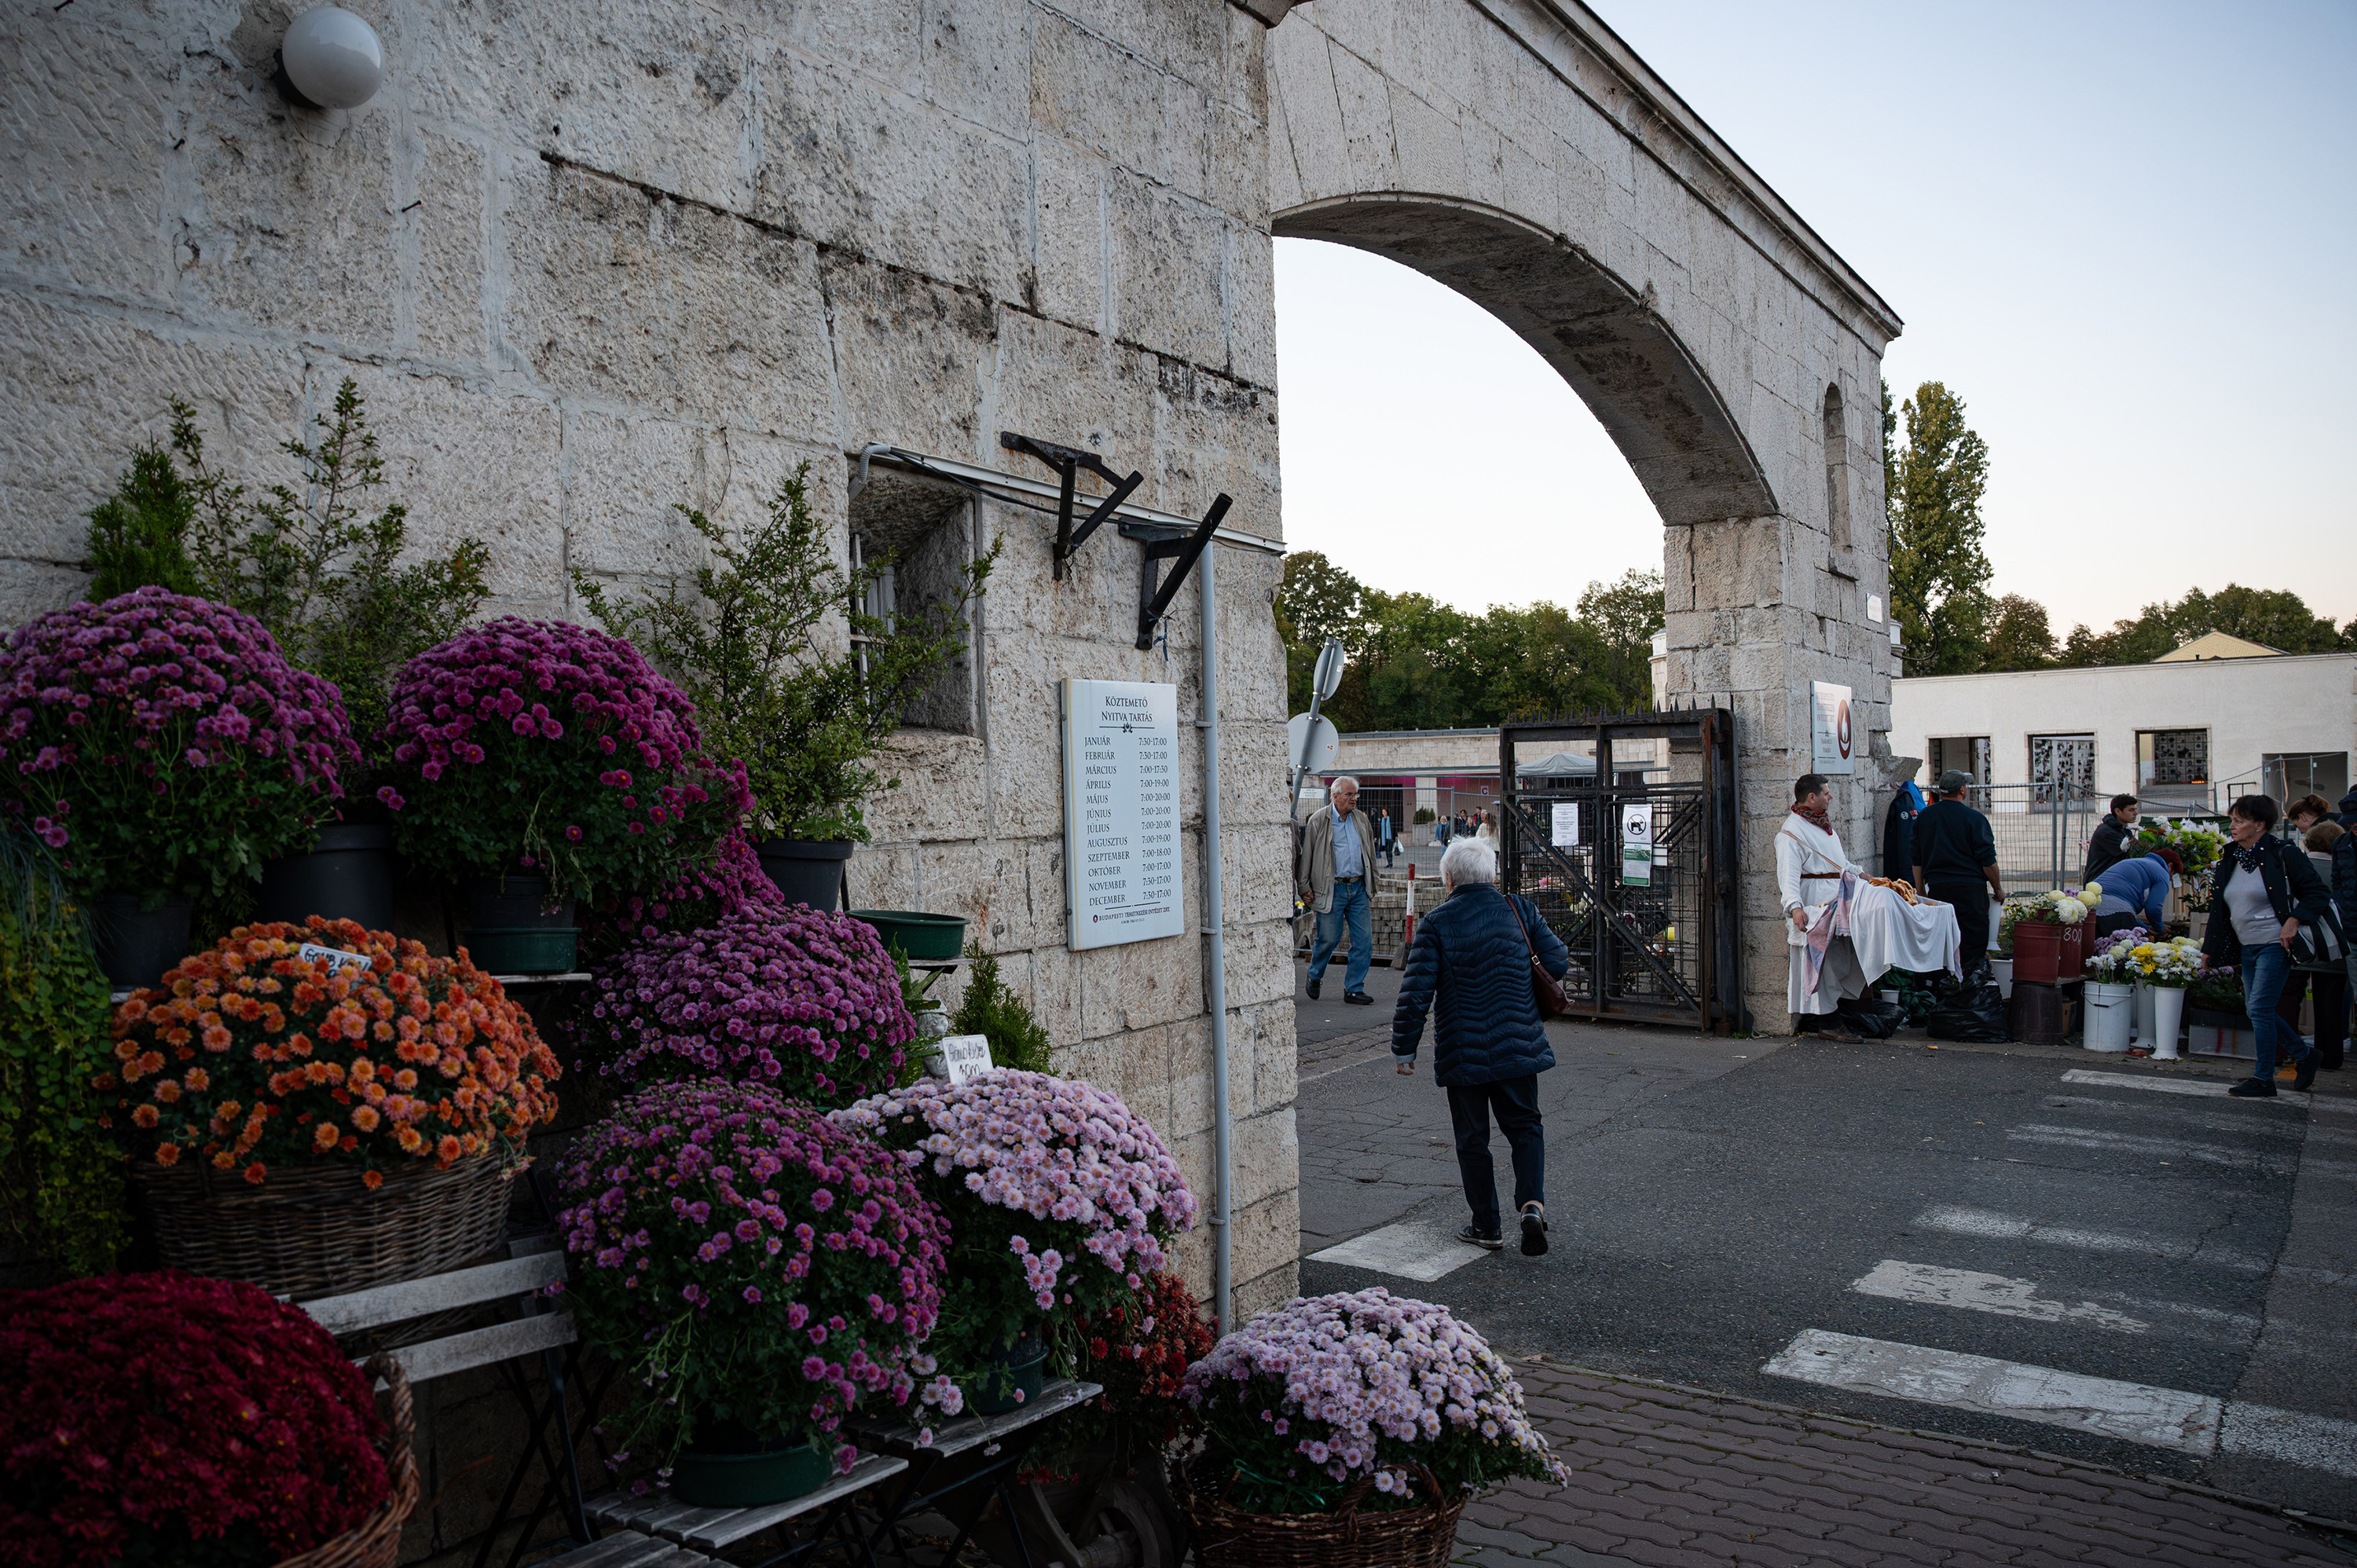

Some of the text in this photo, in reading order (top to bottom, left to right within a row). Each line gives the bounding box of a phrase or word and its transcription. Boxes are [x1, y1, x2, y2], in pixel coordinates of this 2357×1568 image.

[1105, 696, 1148, 707] KÖZTEMETŐ
[1102, 711, 1153, 722] NYITVA TARTÁS
[1084, 735, 1111, 747] JANUÁR
[1085, 750, 1115, 760] FEBRUÁR
[1085, 764, 1116, 775] MÁRCIUS
[1085, 779, 1111, 789] ÁPRILIS
[1086, 793, 1171, 805] MÁJUS 7:00-20:00
[1087, 807, 1171, 820] JÚNIUS 7:00-20:00
[1087, 820, 1171, 834] JÚLIUS 7:00-20:00
[1087, 834, 1171, 848] AUGUSZTUS 7:00-19:00
[1087, 848, 1171, 863] SZEPTEMBER 7:00-18:00
[1088, 862, 1171, 877] OKTÓBER 7:00-17:00
[1088, 880, 1127, 892] NOVEMBER
[1089, 894, 1126, 907] DECEMBER
[1098, 912, 1124, 921] BUDAPESTI
[2063, 927, 2082, 946] 800
